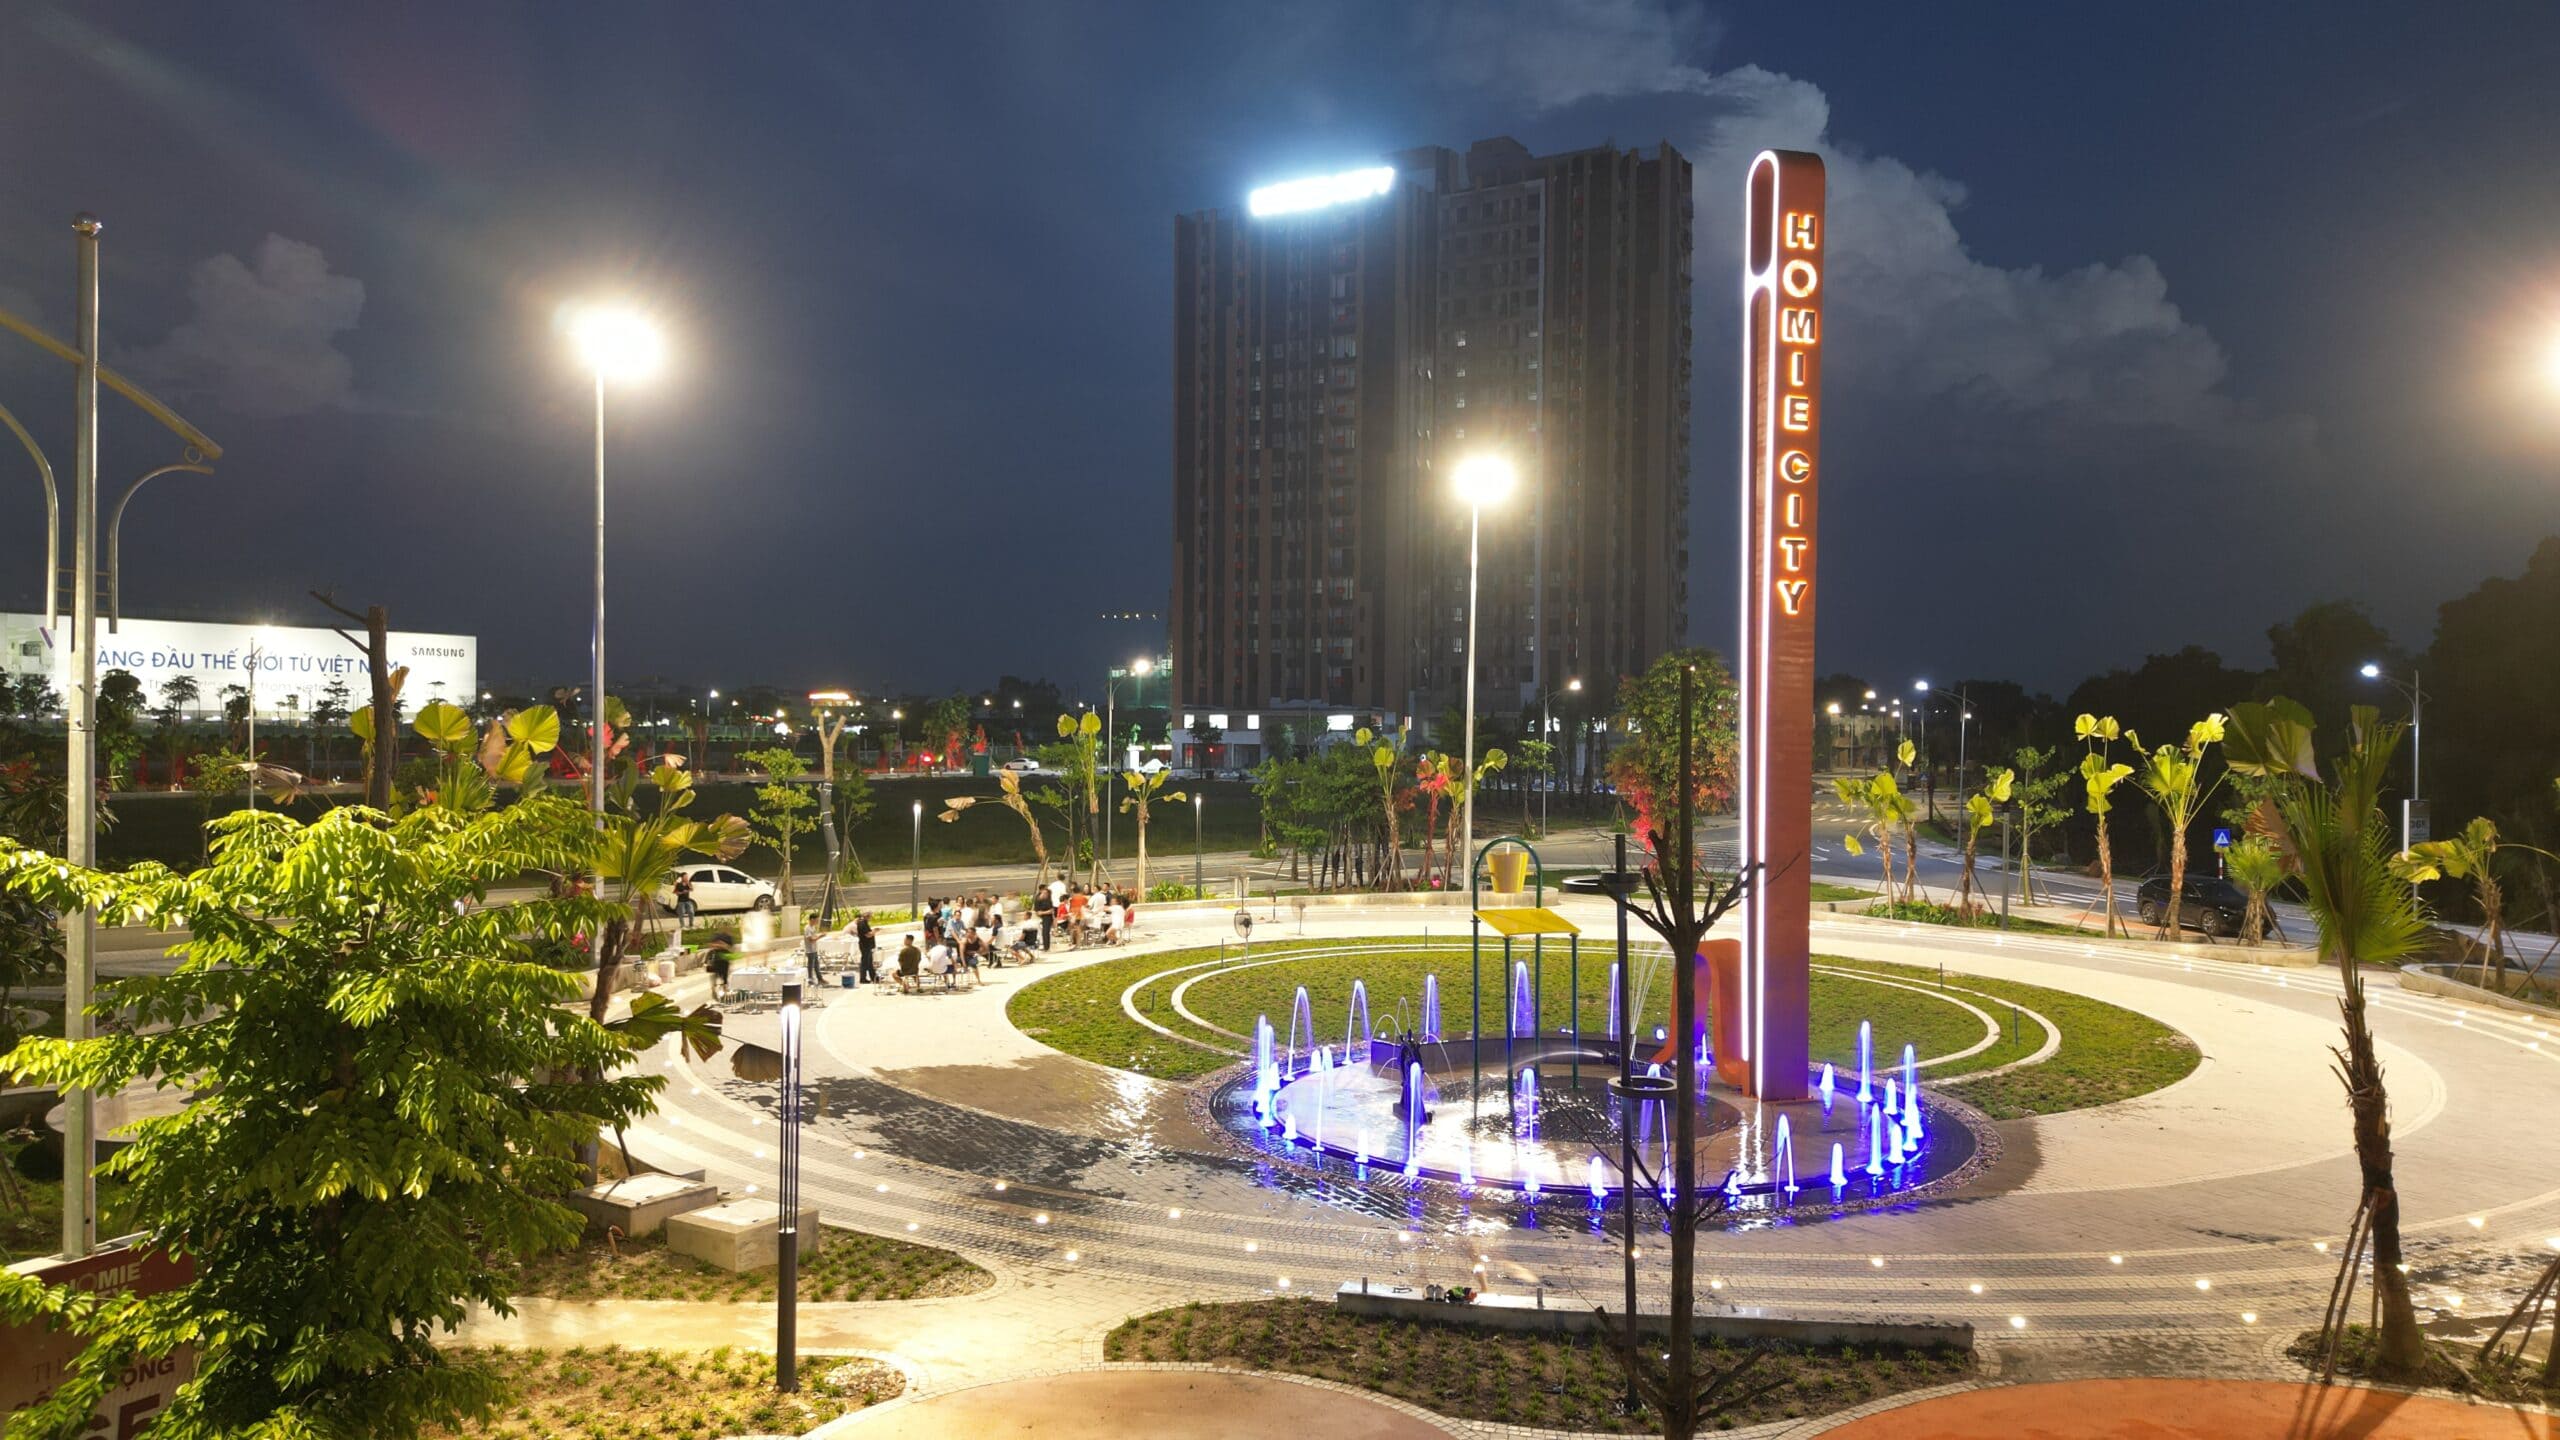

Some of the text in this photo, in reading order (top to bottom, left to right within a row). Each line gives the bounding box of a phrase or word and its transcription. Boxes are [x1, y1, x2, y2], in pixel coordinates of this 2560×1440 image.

[1777, 212, 1817, 615] HOMIE CITY
[96, 645, 145, 667] ÀNG
[151, 645, 194, 669] ĐẦU
[201, 648, 239, 670] THẾ
[289, 653, 313, 672] TỪ
[359, 659, 399, 674] NM
[411, 646, 466, 658] SAMSUNG
